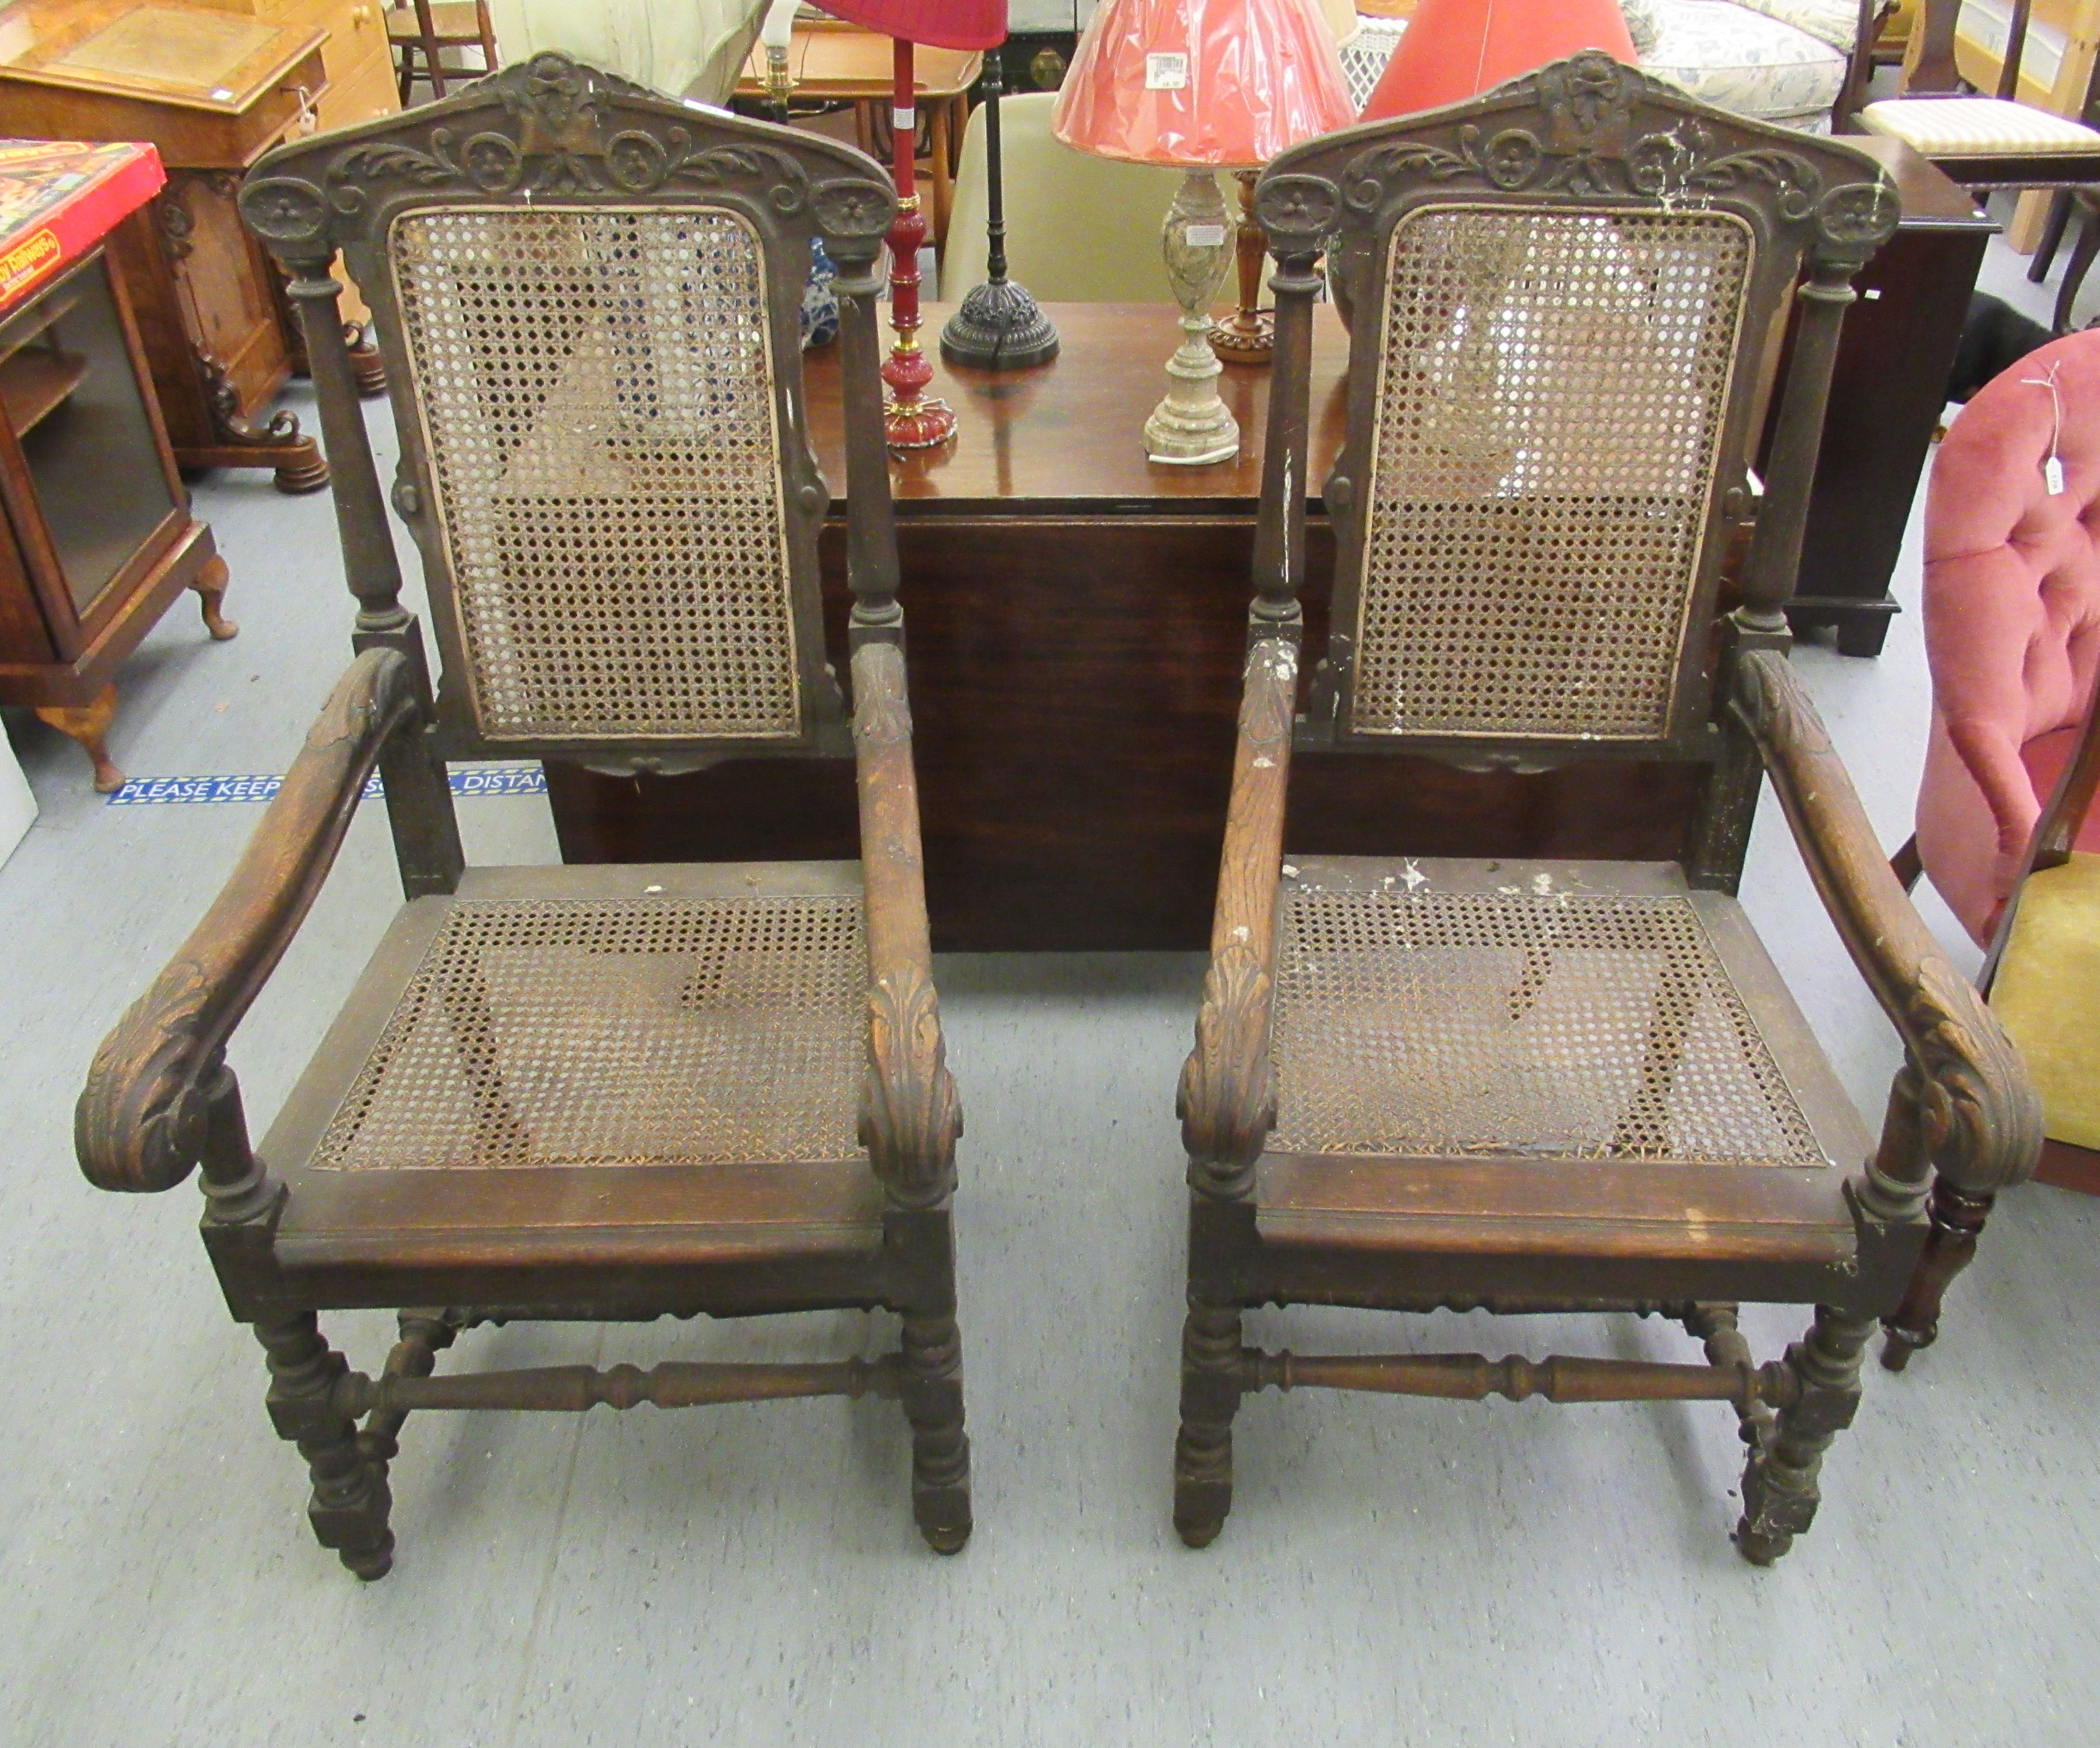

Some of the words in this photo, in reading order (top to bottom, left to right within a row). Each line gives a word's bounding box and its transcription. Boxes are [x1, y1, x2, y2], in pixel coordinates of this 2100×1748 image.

[8, 237, 49, 274] Railways
[119, 782, 213, 797] PLEASE
[216, 781, 282, 796] KEEP
